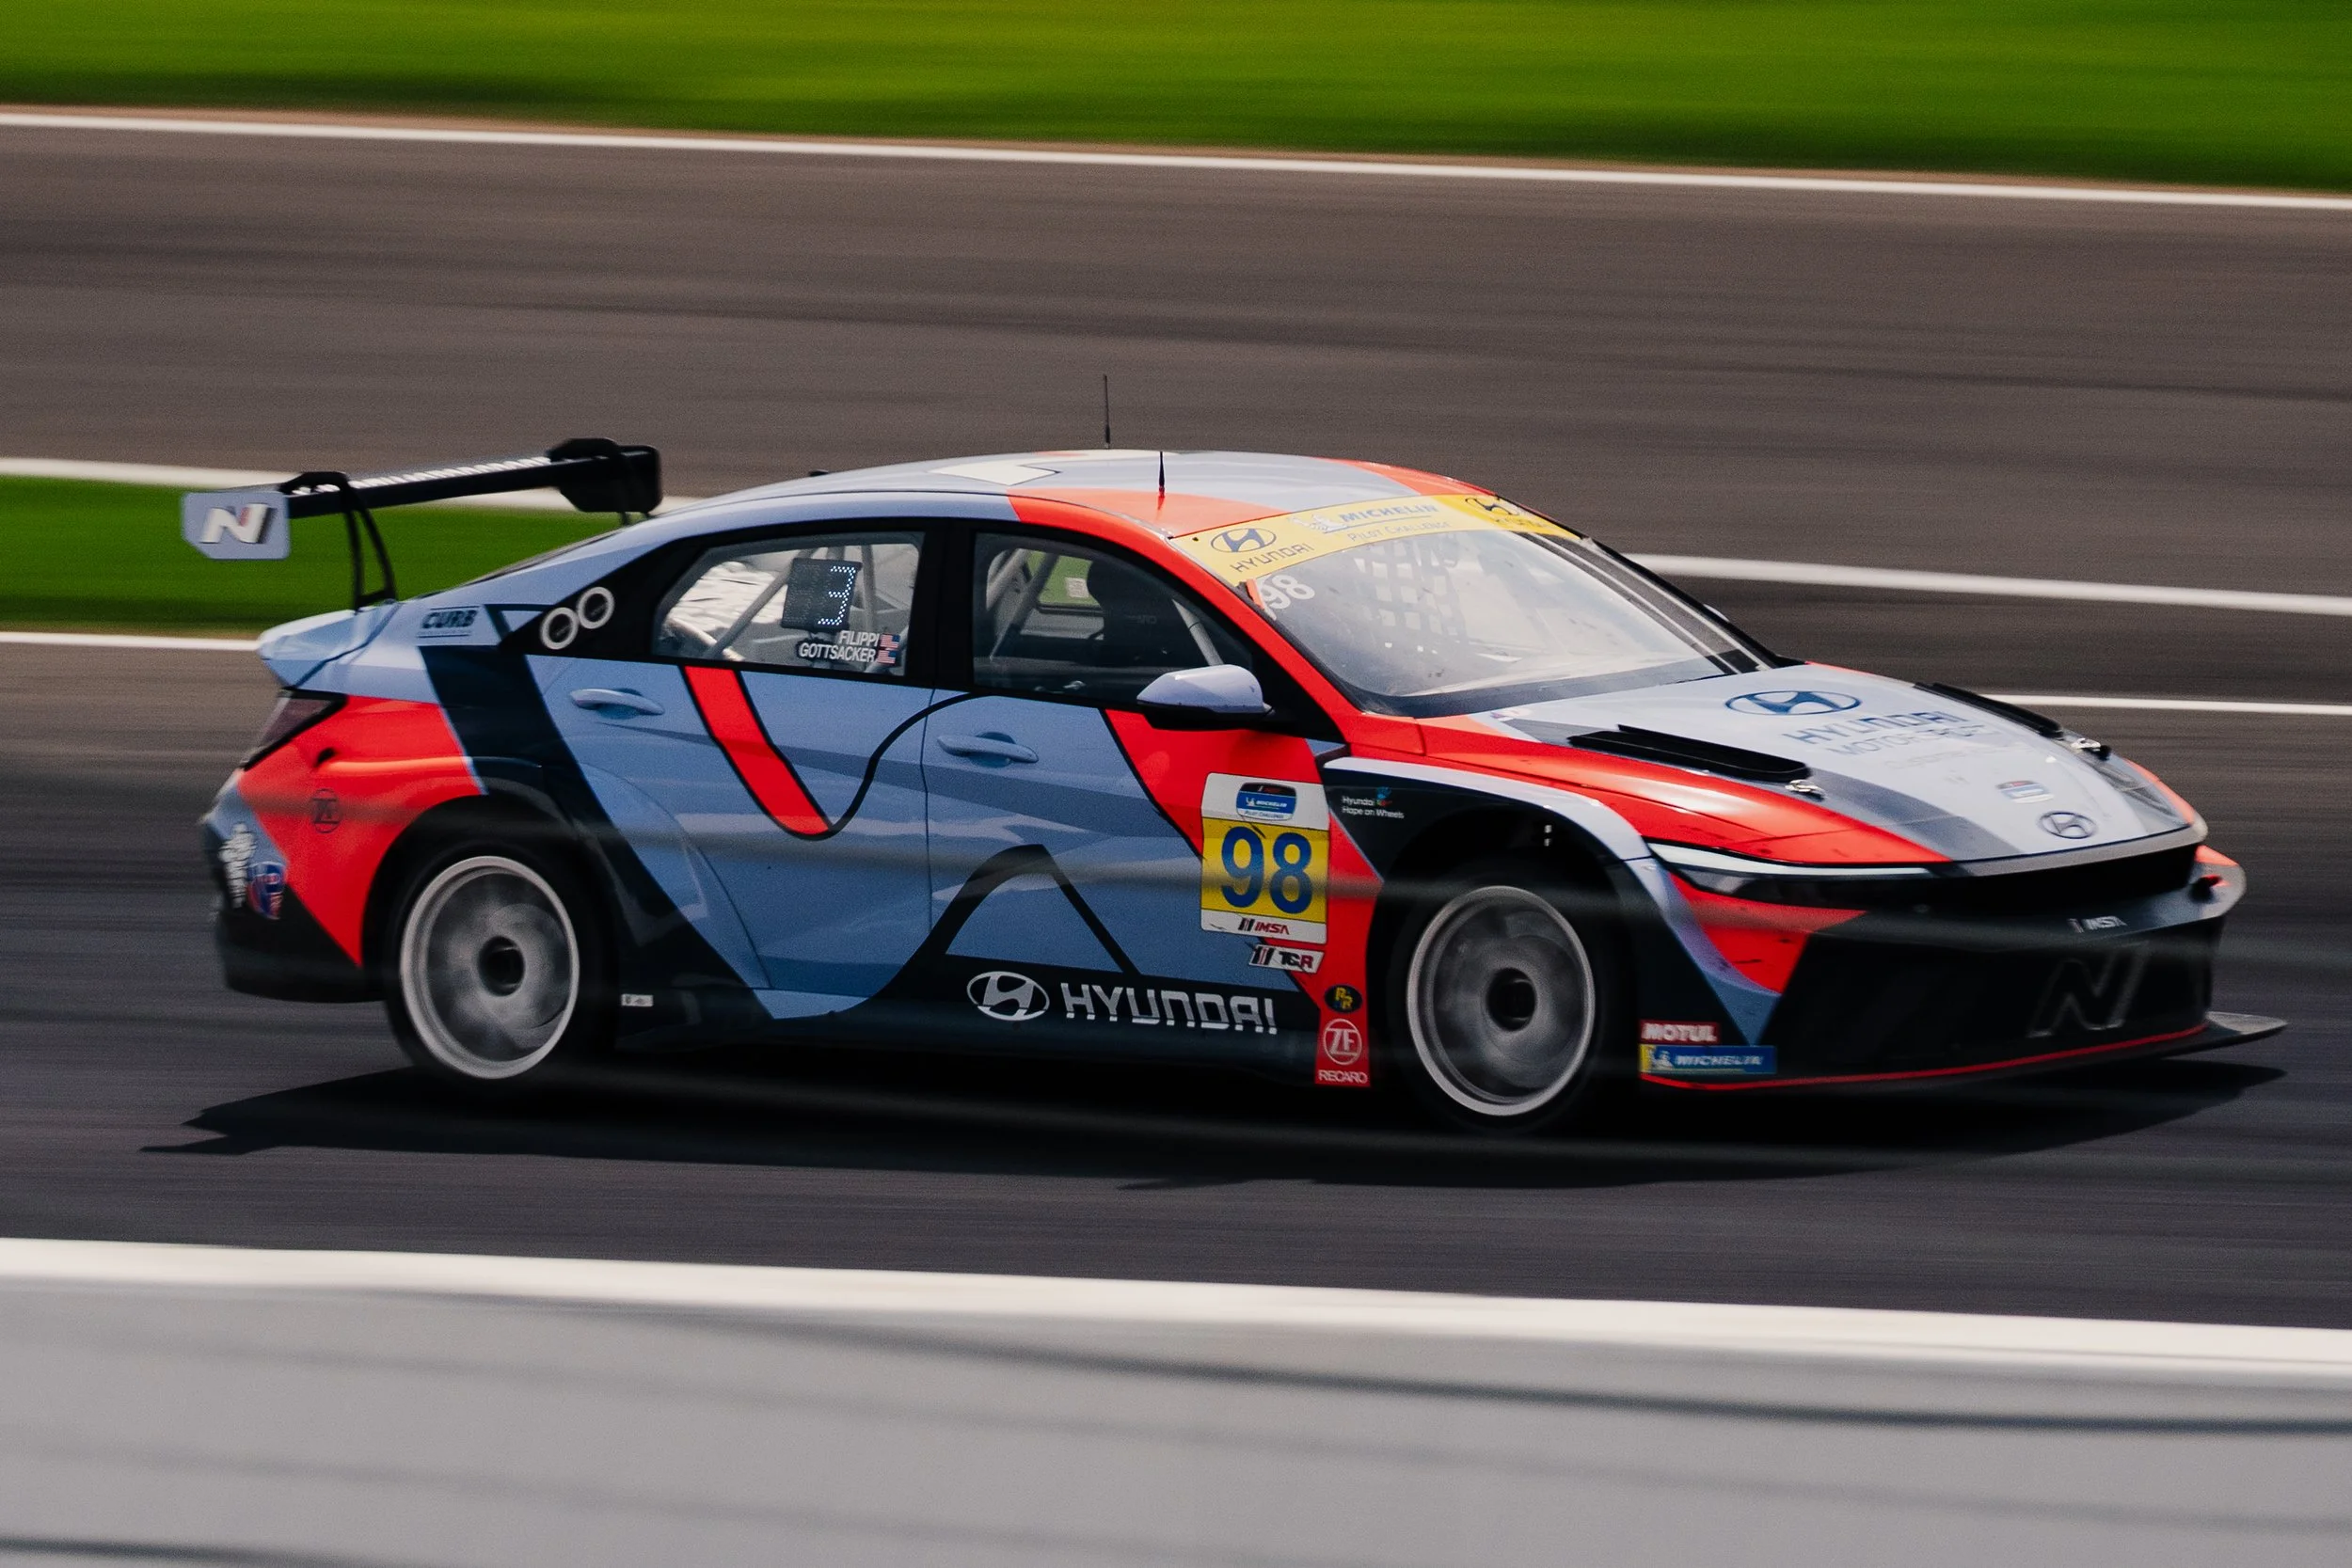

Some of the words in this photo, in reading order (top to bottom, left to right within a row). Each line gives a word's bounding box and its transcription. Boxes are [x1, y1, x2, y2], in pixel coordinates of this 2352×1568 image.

[1340, 502, 1438, 523] MICHELIN
[1230, 543, 1314, 573] HYUNDAI
[818, 565, 856, 626] 3
[1259, 574, 1316, 610] 98
[422, 610, 478, 629] CURB
[838, 629, 881, 647] FILIPPI
[799, 641, 877, 663] GOTTSACKER
[1783, 710, 1969, 745] HYUNDAI
[1342, 796, 1375, 807] Hyundai
[1342, 806, 1363, 816] Hope
[1376, 808, 1405, 819] Wheels
[1221, 826, 1313, 914] 98
[1255, 921, 1290, 935] IMSA
[1279, 951, 1314, 969] TCR
[1060, 982, 1278, 1035] HYUNDAI
[1641, 1022, 1717, 1042] MOTUL
[1674, 1054, 1764, 1066] MICHELIN
[1318, 1069, 1368, 1084] RECARO
